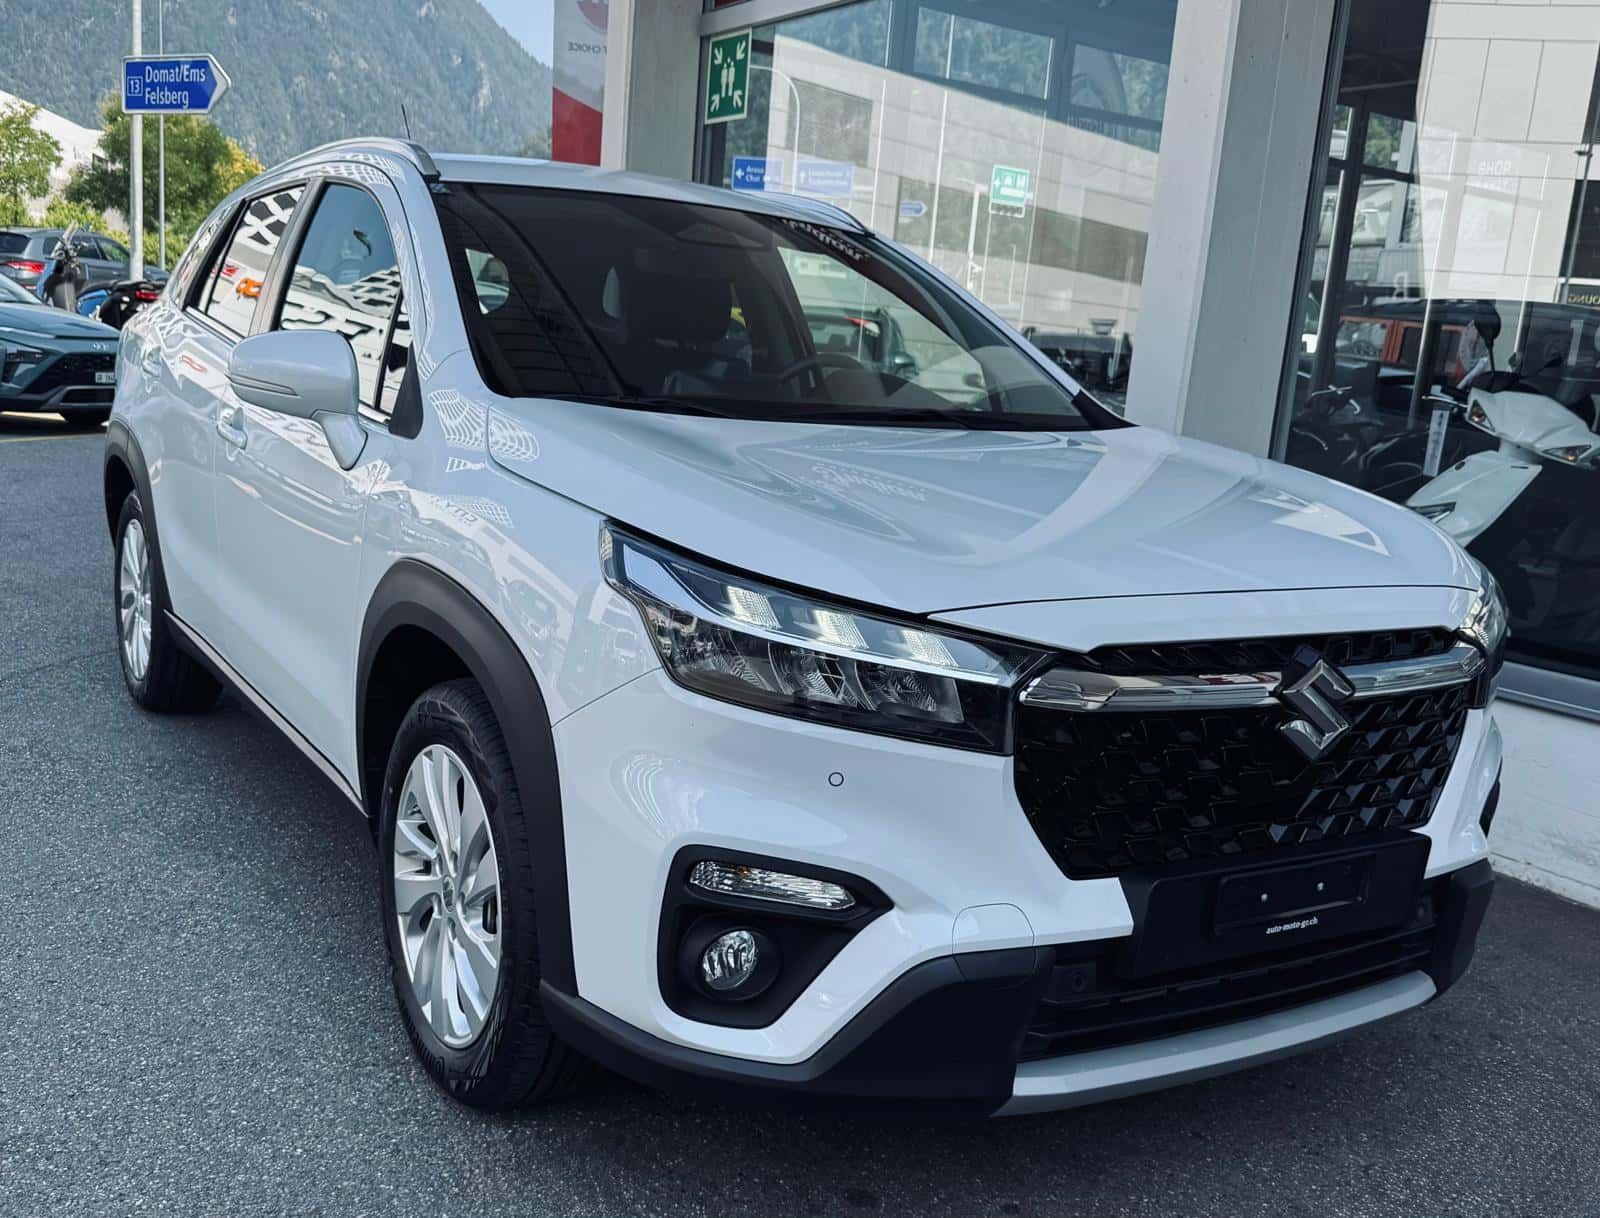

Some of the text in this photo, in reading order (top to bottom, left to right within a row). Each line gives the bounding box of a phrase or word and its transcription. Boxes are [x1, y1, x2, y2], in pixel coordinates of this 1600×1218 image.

[145, 65, 205, 82] Domat/Ems
[130, 79, 140, 94] 13
[145, 86, 189, 108] Felsberg
[1266, 916, 1319, 935] auto-moto-gr.ch
